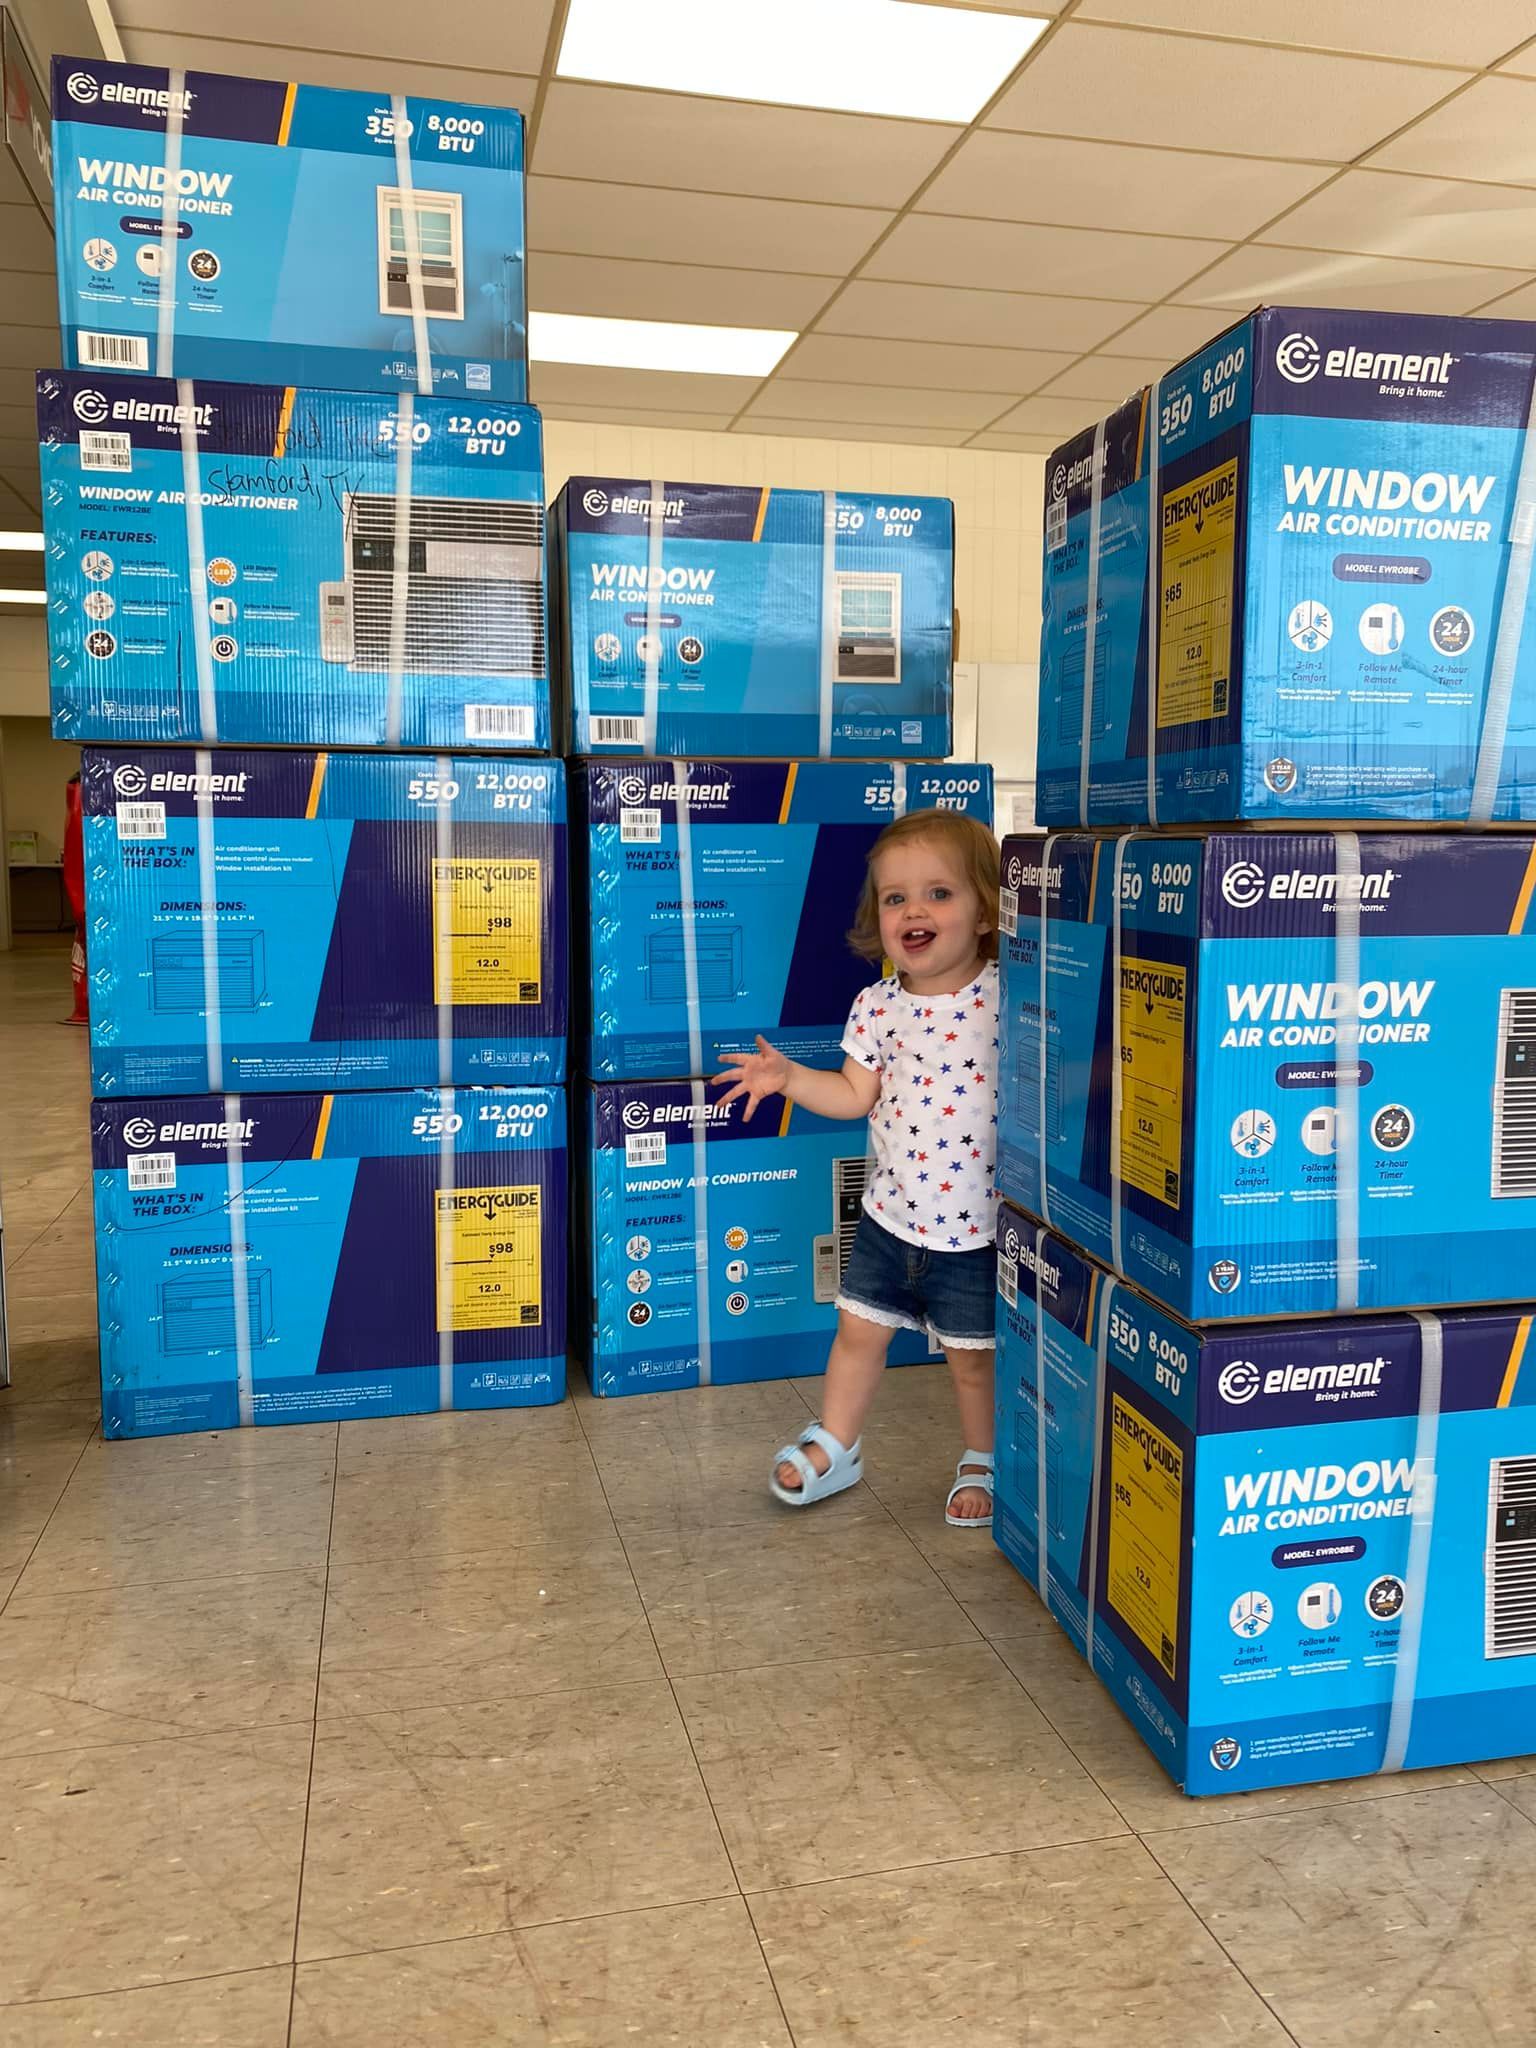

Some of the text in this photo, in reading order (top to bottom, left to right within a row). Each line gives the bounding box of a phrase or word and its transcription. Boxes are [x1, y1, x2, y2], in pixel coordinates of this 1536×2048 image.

[101, 82, 192, 110] element
[365, 115, 484, 139] 350 8,000
[438, 135, 475, 153] BTU
[78, 156, 233, 198] WINDOW
[76, 186, 233, 216] AIR CONDIONER
[197, 261, 212, 269] 24
[1325, 347, 1450, 383] element
[1160, 347, 1245, 437] 350 8,000
[1379, 385, 1445, 398] Bring it home.
[1208, 382, 1236, 420] BTU
[112, 399, 212, 425] element
[378, 417, 520, 443] 550 12,000
[465, 438, 505, 455] BTU
[1283, 465, 1496, 514] WINDOW
[79, 486, 298, 510] WINDOW AIR CONDITIONER
[1164, 472, 1235, 528] ENERGYGUIDE
[79, 503, 110, 512] MODEL:
[611, 496, 685, 516] element
[875, 507, 922, 521] 8,000
[884, 524, 913, 537] BTU
[1277, 512, 1491, 542] AIR CONDITIONER
[80, 529, 157, 543] FEATURES:
[1345, 563, 1420, 575] MODEL: EWR08BE
[591, 563, 715, 590] WINDOW
[590, 589, 714, 605] AIR CONITIONER
[1165, 583, 1182, 602] $65
[1441, 623, 1463, 636] 24
[92, 639, 109, 650] 24
[1186, 645, 1202, 660] 12.0
[1296, 661, 1323, 671] 3-in-1
[1359, 663, 1387, 672] Follow
[1433, 664, 1468, 674] 24-hour
[1291, 672, 1327, 682] Comfort
[1364, 675, 1397, 684] Remote
[1439, 677, 1463, 686] Timer
[151, 771, 247, 792] element
[408, 774, 547, 800] 550 12,000
[649, 782, 731, 801] element
[864, 780, 980, 804] 550 12,000
[493, 794, 532, 808] BTU
[936, 797, 968, 811] BTU
[123, 846, 195, 857] WHAT'S IN
[626, 851, 671, 860] WHAT'S
[124, 859, 187, 868] THE BOX:
[626, 862, 679, 871] THE BOX:
[434, 866, 537, 882] ENERGYGUIDE
[1022, 863, 1063, 888] element
[1113, 863, 1191, 900] 50 8,000
[1269, 869, 1394, 900] element
[160, 902, 246, 911] DIMENONS:
[656, 900, 728, 910] DIMESIONS:
[1158, 892, 1184, 914] BTU
[1358, 903, 1387, 912] home.
[488, 917, 512, 928] $98
[476, 959, 500, 967] 12.0
[1115, 967, 1184, 1001] NERGYGUIDE
[1226, 980, 1436, 1021] WINDOW
[1220, 1023, 1430, 1048] AIR CONDIONER
[1288, 1071, 1320, 1080] MODEL:
[412, 1103, 548, 1135] 550 12,000
[653, 1102, 731, 1122] element
[160, 1119, 254, 1141] element
[496, 1123, 533, 1138] BTU
[1137, 1118, 1153, 1135] 12.0
[1382, 1119, 1403, 1133] 24
[1239, 1166, 1265, 1175] 3-in-1
[1301, 1164, 1331, 1173] Follow
[1374, 1160, 1408, 1169] 24-hour
[626, 1169, 798, 1193] WINDOW AIR CONDITIONER
[1380, 1171, 1404, 1180] Timer
[1235, 1178, 1269, 1188] Comfort
[133, 1193, 203, 1205] WHAT'S IN
[438, 1192, 538, 1211] ENERGYGUIDE
[133, 1205, 196, 1216] THE BOX:
[626, 1215, 686, 1227] FEATURES:
[170, 1243, 254, 1256] DIMENSIOS:
[489, 1243, 513, 1254] $98
[1020, 1243, 1061, 1290] element
[478, 1284, 501, 1293] 12.0
[634, 1309, 646, 1317] 24
[1110, 1313, 1188, 1374] 350 8,000
[1156, 1362, 1181, 1396] BTU
[1264, 1357, 1385, 1394] element
[1315, 1389, 1379, 1402] Bring it home.
[1114, 1406, 1181, 1482] ENERGYGUIDE
[1224, 1458, 1420, 1512] WINDOW
[1115, 1482, 1131, 1507] $65
[1218, 1514, 1261, 1537] AIR
[1284, 1550, 1314, 1560] MODEL:
[1135, 1565, 1150, 1589] 12.0
[1378, 1590, 1397, 1602] 24
[1299, 1635, 1341, 1646] Follow Me
[1369, 1630, 1402, 1639] 24-hou
[1238, 1645, 1263, 1654] 3-in-1
[1375, 1639, 1398, 1648] Timer
[1304, 1647, 1335, 1657] Remote
[1234, 1656, 1268, 1666] Comfort
